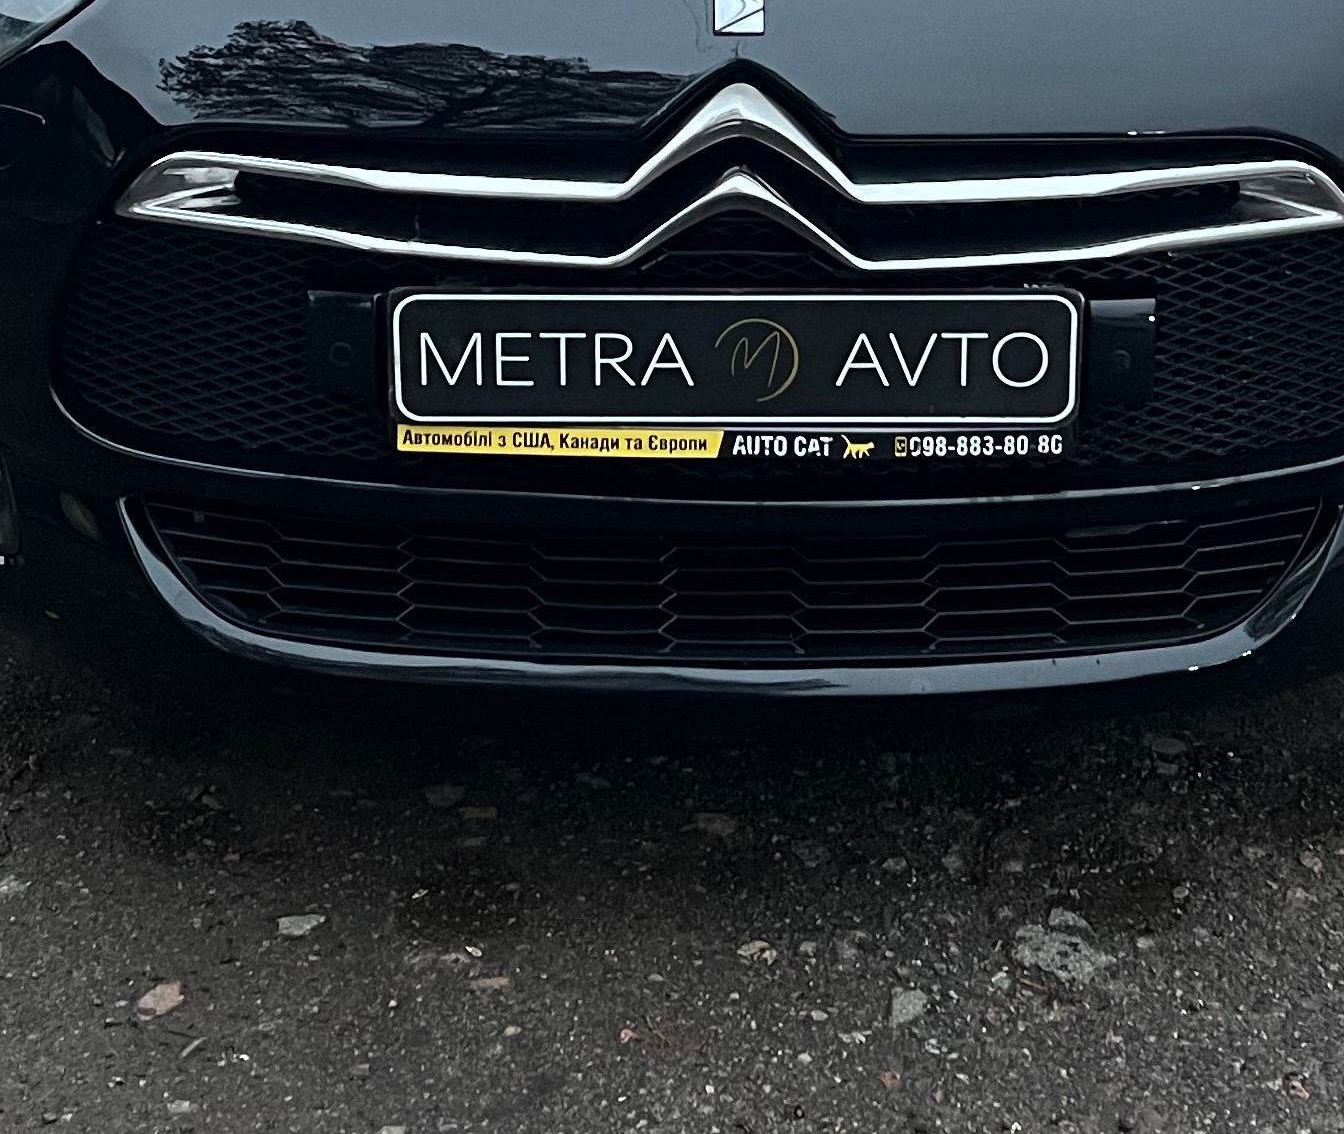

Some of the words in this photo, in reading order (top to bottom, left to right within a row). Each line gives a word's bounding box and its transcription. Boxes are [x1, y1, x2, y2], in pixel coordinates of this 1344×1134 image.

[418, 332, 695, 388] METRA
[835, 332, 1051, 389] AVTO
[402, 429, 492, 447] Автомобілі
[497, 435, 507, 447] з
[512, 431, 554, 451] США,
[559, 433, 620, 452] Канади
[624, 437, 643, 450] та
[648, 435, 707, 454] Європи
[732, 434, 788, 457] AUTO
[794, 435, 834, 457] CAT
